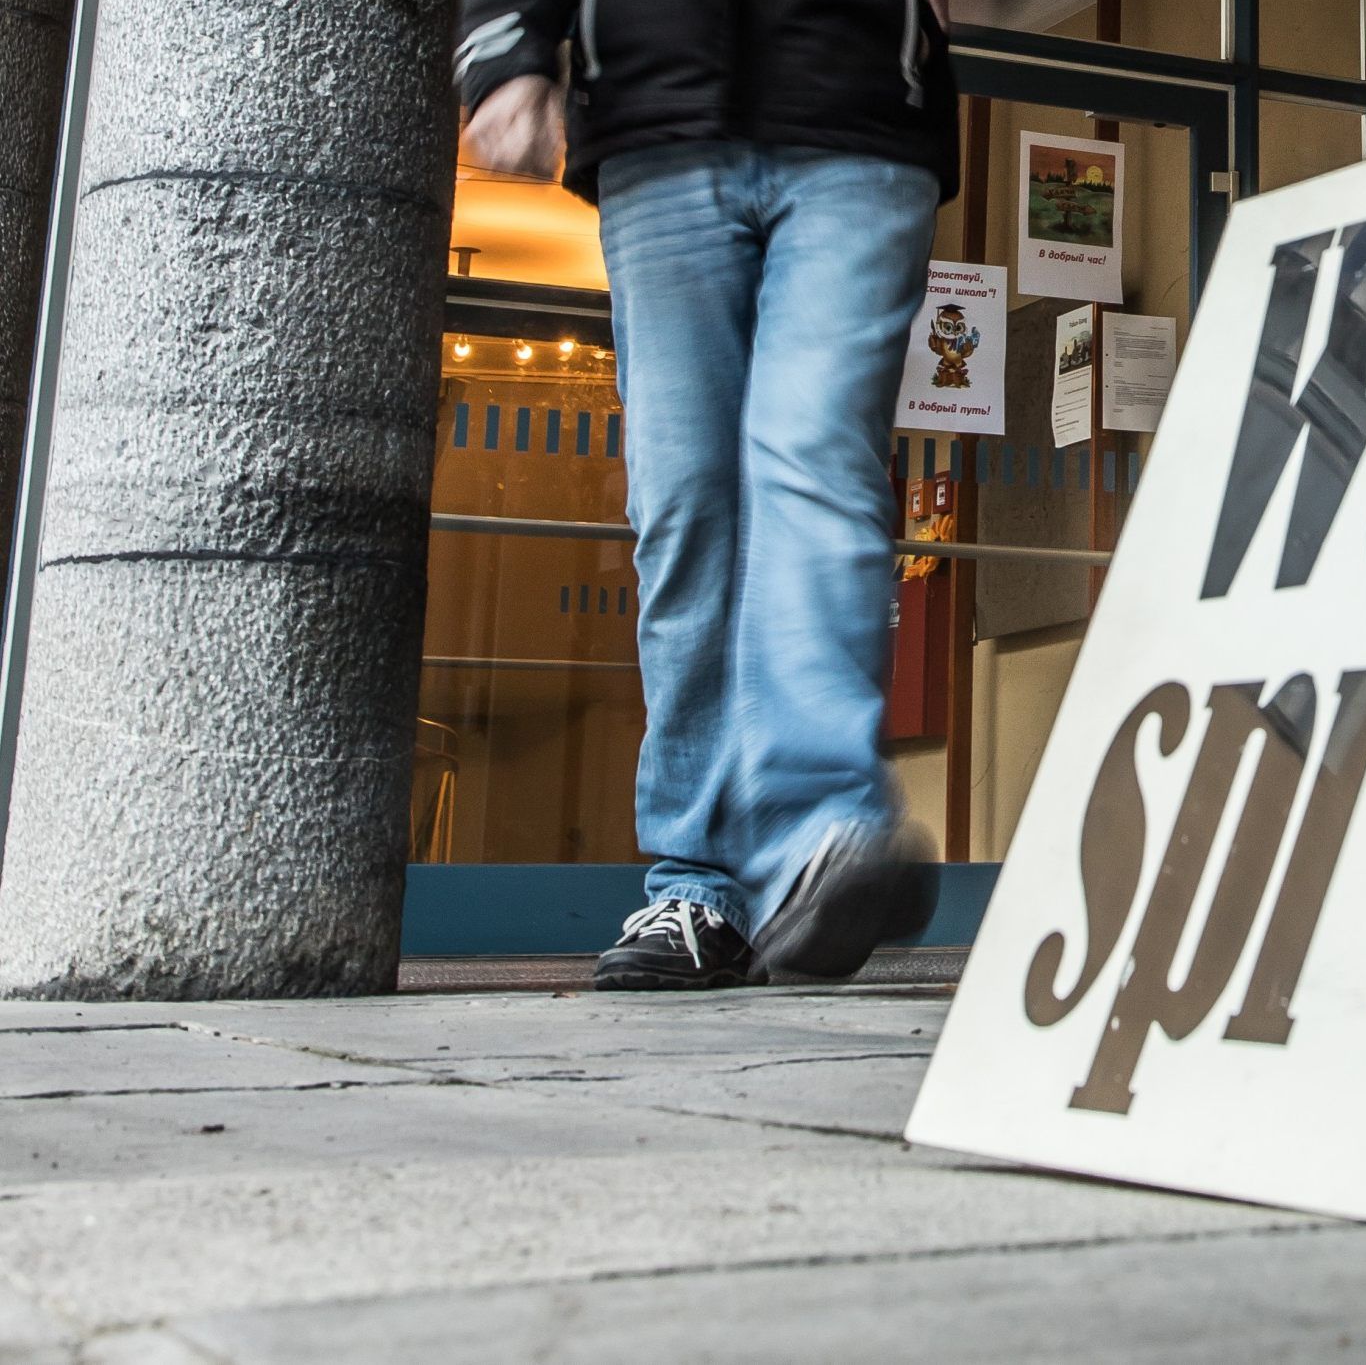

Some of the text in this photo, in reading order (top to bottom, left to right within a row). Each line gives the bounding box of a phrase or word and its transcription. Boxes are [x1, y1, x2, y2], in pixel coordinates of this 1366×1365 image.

[1038, 249, 1107, 265] В добрый час!
[927, 268, 983, 283] дравствуй,
[908, 400, 992, 416] В добрый путь!
